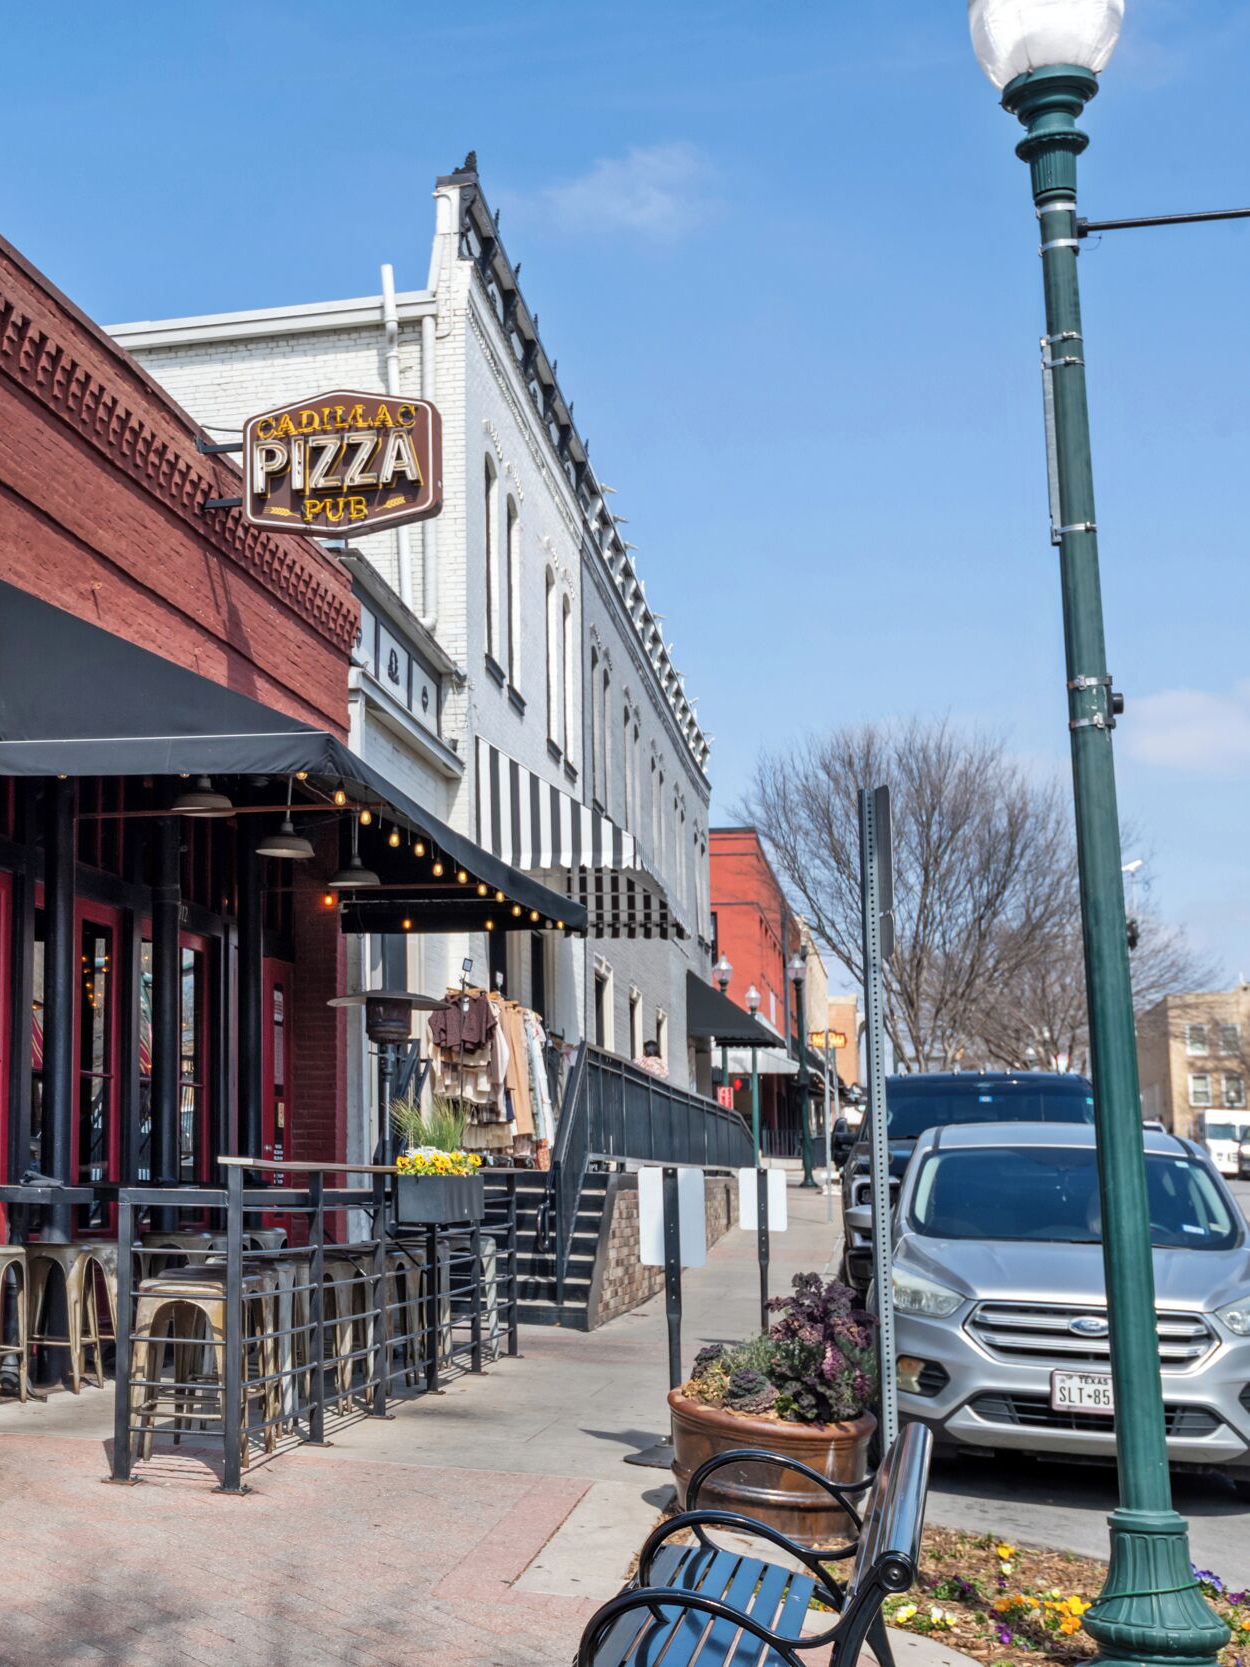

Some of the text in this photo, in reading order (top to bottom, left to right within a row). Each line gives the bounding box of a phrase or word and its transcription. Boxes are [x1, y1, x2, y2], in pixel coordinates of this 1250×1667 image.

[257, 404, 417, 440] CADILLAC
[253, 427, 422, 498] PIZZA
[303, 496, 368, 522] PUB
[1079, 1375, 1109, 1386] TEXAS
